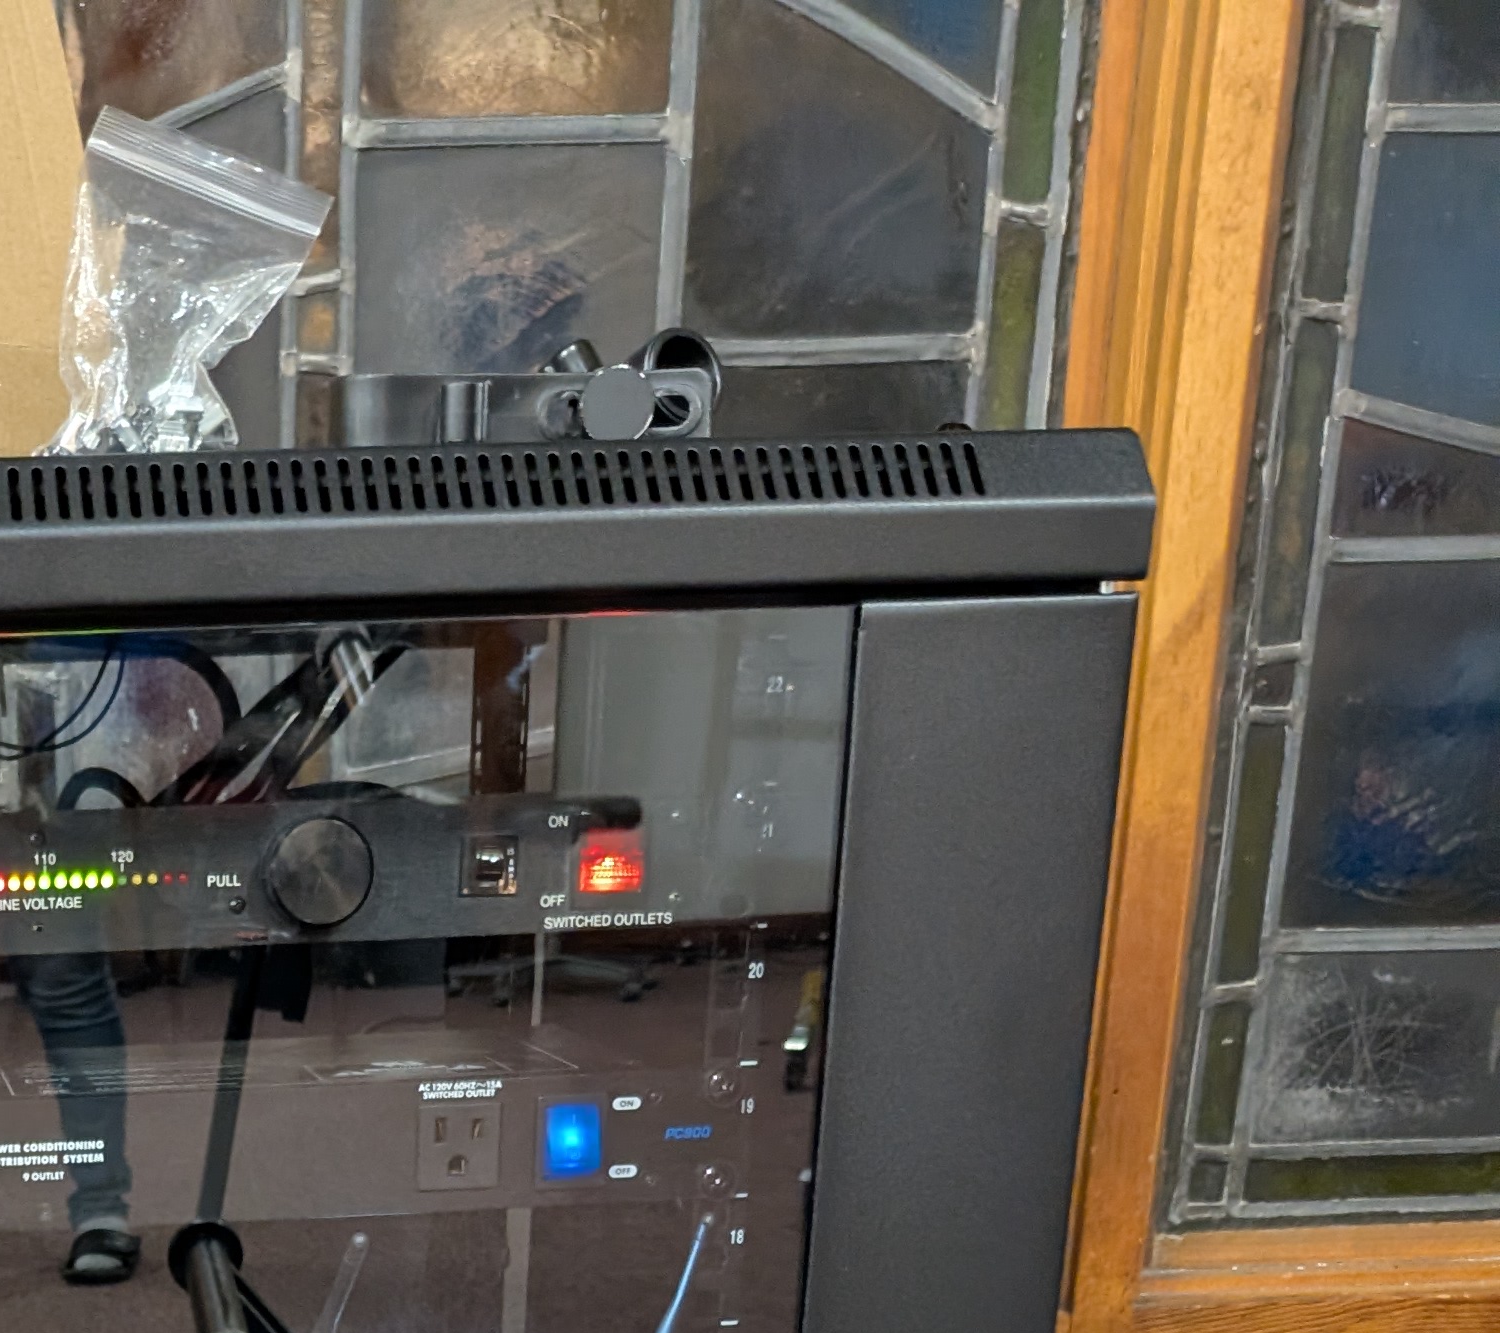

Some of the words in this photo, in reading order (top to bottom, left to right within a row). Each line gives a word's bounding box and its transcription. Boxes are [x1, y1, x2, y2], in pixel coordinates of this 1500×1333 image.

[548, 816, 569, 828] ON
[34, 853, 56, 865] 110
[111, 851, 133, 863] 120
[207, 875, 240, 888] PULL
[23, 897, 82, 911] VOLTAGE
[540, 894, 565, 908] OFF
[544, 913, 611, 929] SWITCHED
[614, 912, 673, 926] OUTLETS
[748, 962, 764, 978] 20
[418, 1084, 430, 1092] AC
[432, 1082, 453, 1091] 120V
[423, 1090, 465, 1100] SWITCHED
[466, 1089, 496, 1098] OUTLET
[620, 1100, 634, 1108] ON
[741, 1098, 754, 1114] 19
[23, 1140, 105, 1154] CONDITIONING
[63, 1153, 105, 1164] SYSTEM
[22, 1172, 30, 1182] 9
[31, 1171, 65, 1182] OUTLET
[615, 1167, 631, 1175] OFF
[730, 1229, 744, 1244] 18
